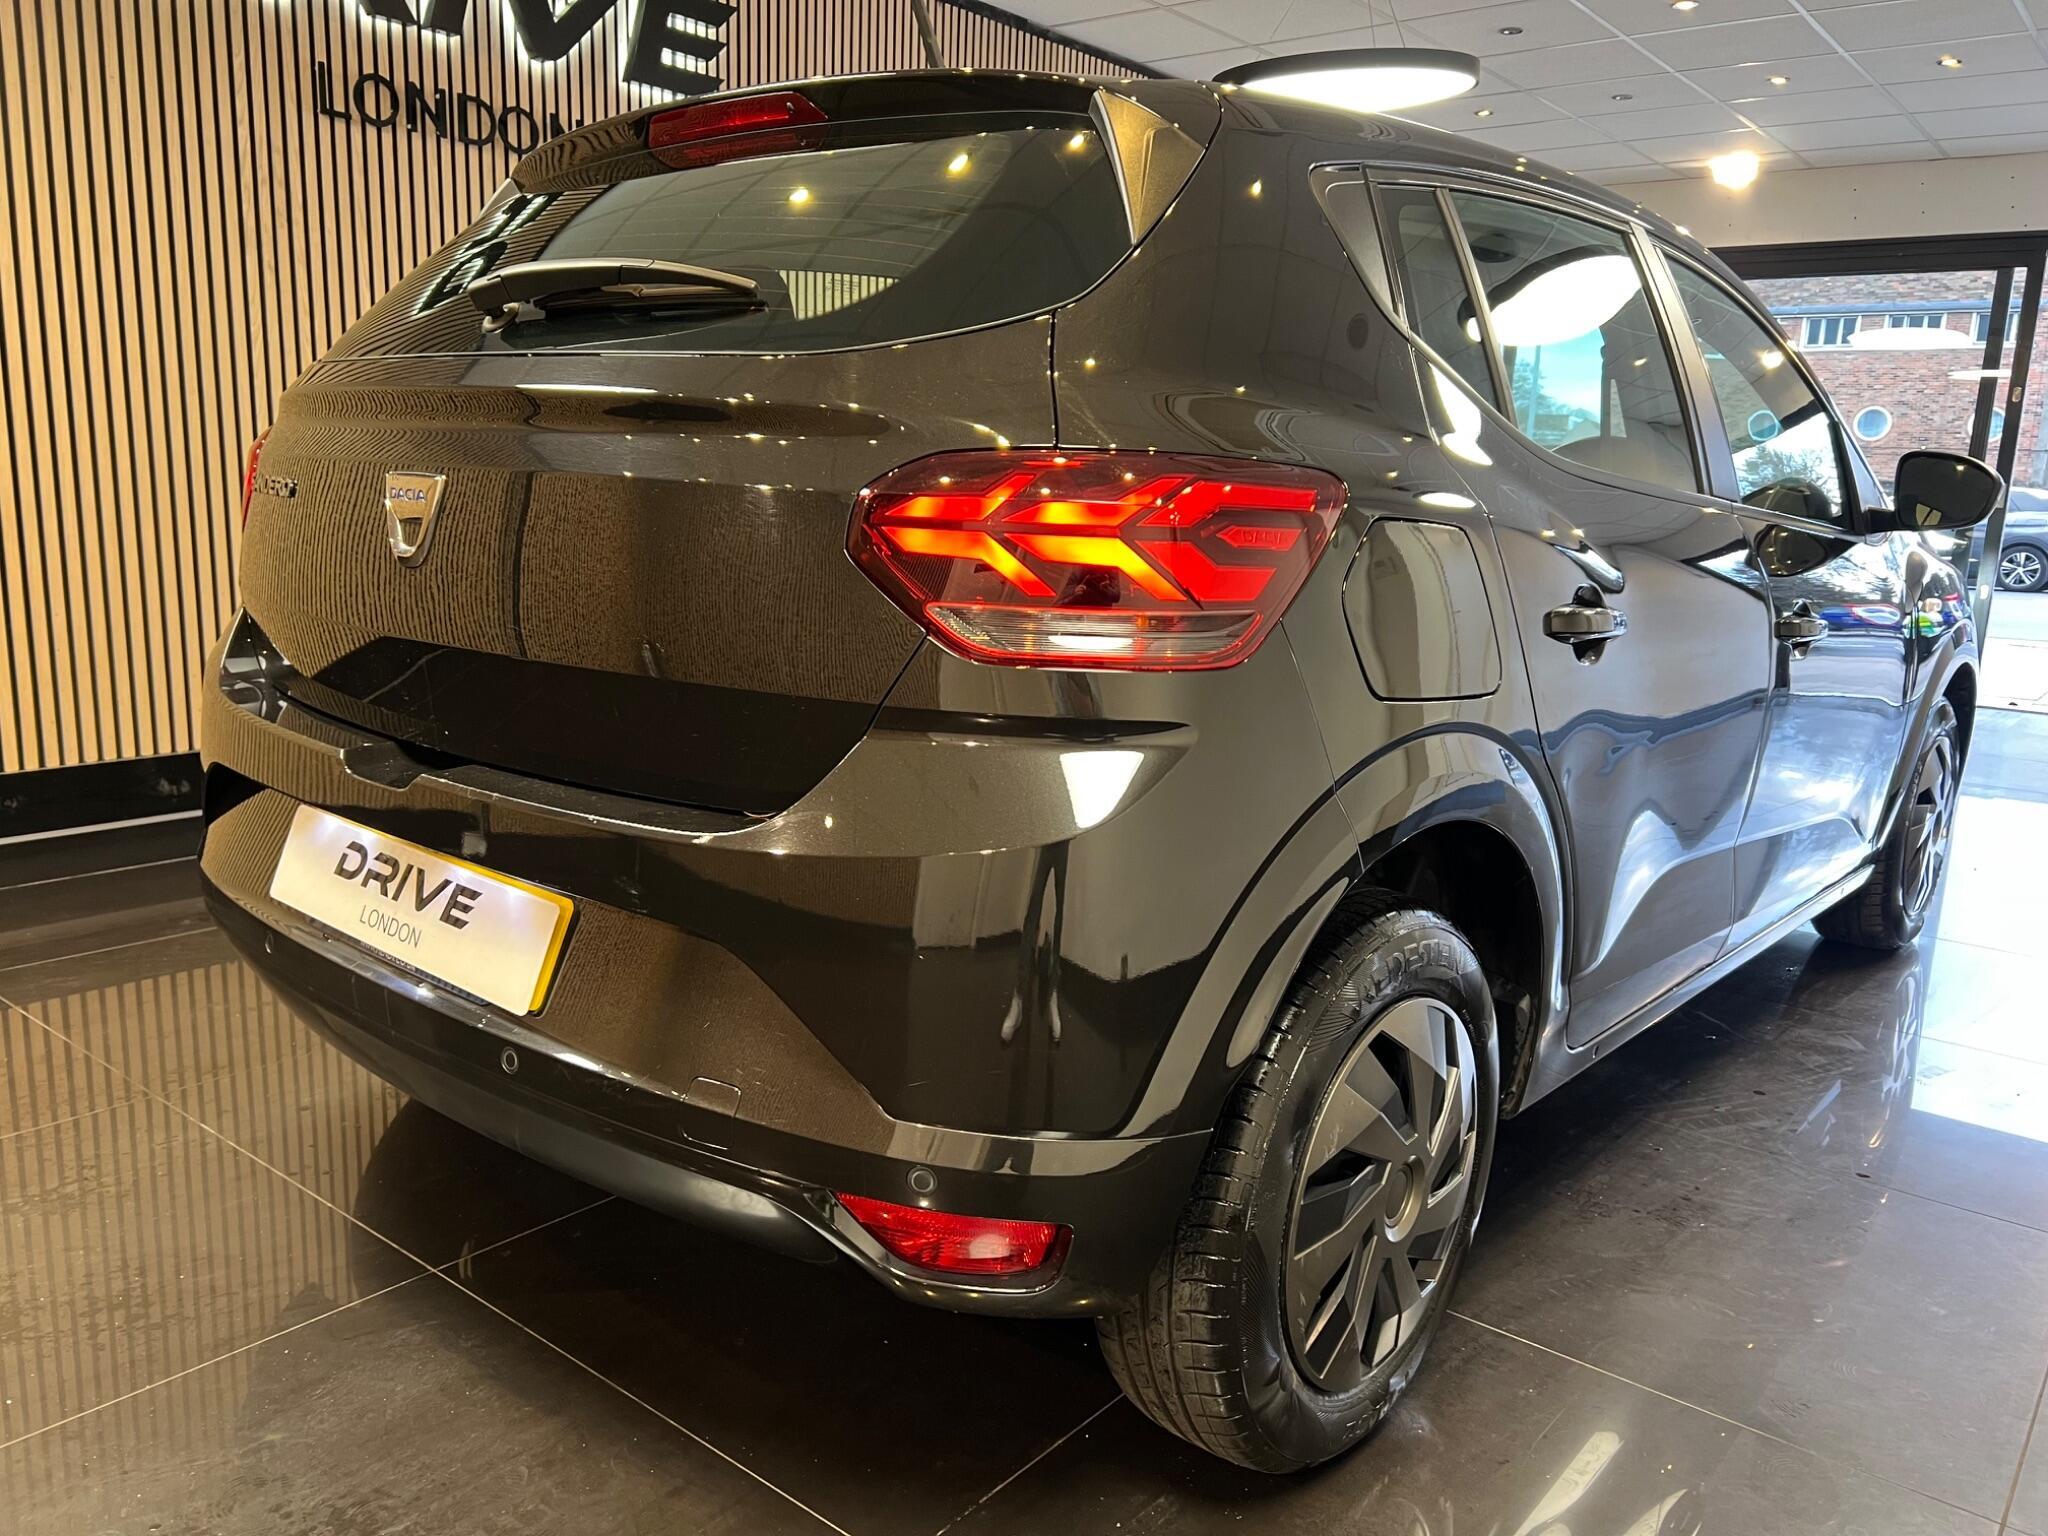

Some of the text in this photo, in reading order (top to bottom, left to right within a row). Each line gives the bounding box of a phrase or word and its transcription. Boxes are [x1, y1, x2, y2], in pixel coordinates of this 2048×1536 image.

[389, 486, 426, 503] DACIA
[333, 840, 484, 930] DRIVE
[359, 904, 423, 949] LONDON
